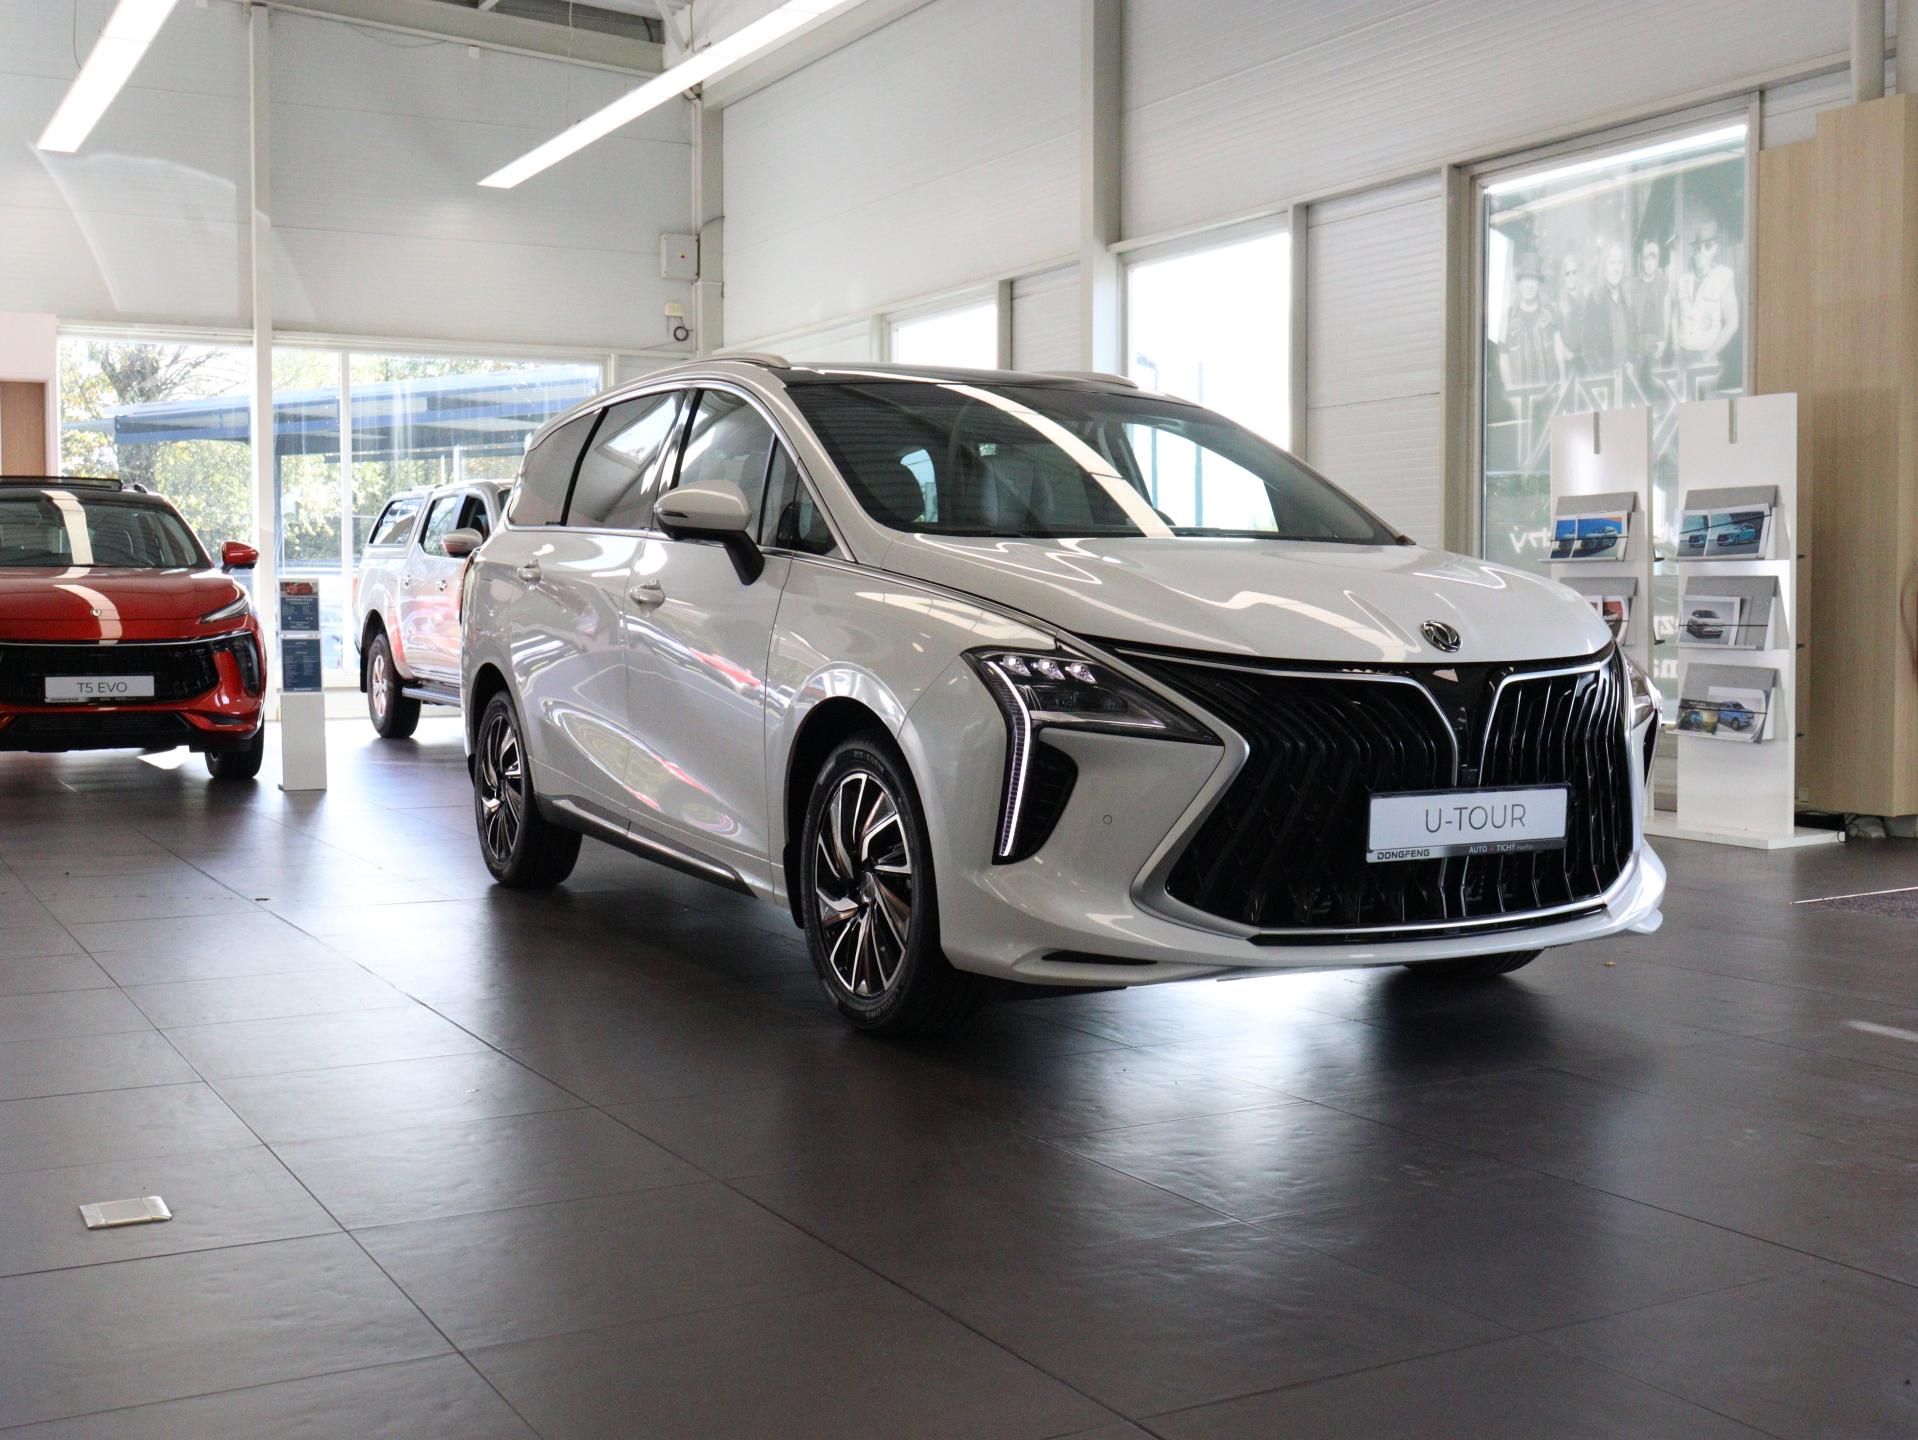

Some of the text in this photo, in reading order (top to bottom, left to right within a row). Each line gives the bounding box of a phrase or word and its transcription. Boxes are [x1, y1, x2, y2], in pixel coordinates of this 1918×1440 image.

[76, 681, 128, 694] T5 EVO
[1425, 803, 1527, 834] U-TOUR
[1377, 848, 1431, 860] DONGFENG
[1469, 845, 1488, 854] AUTO
